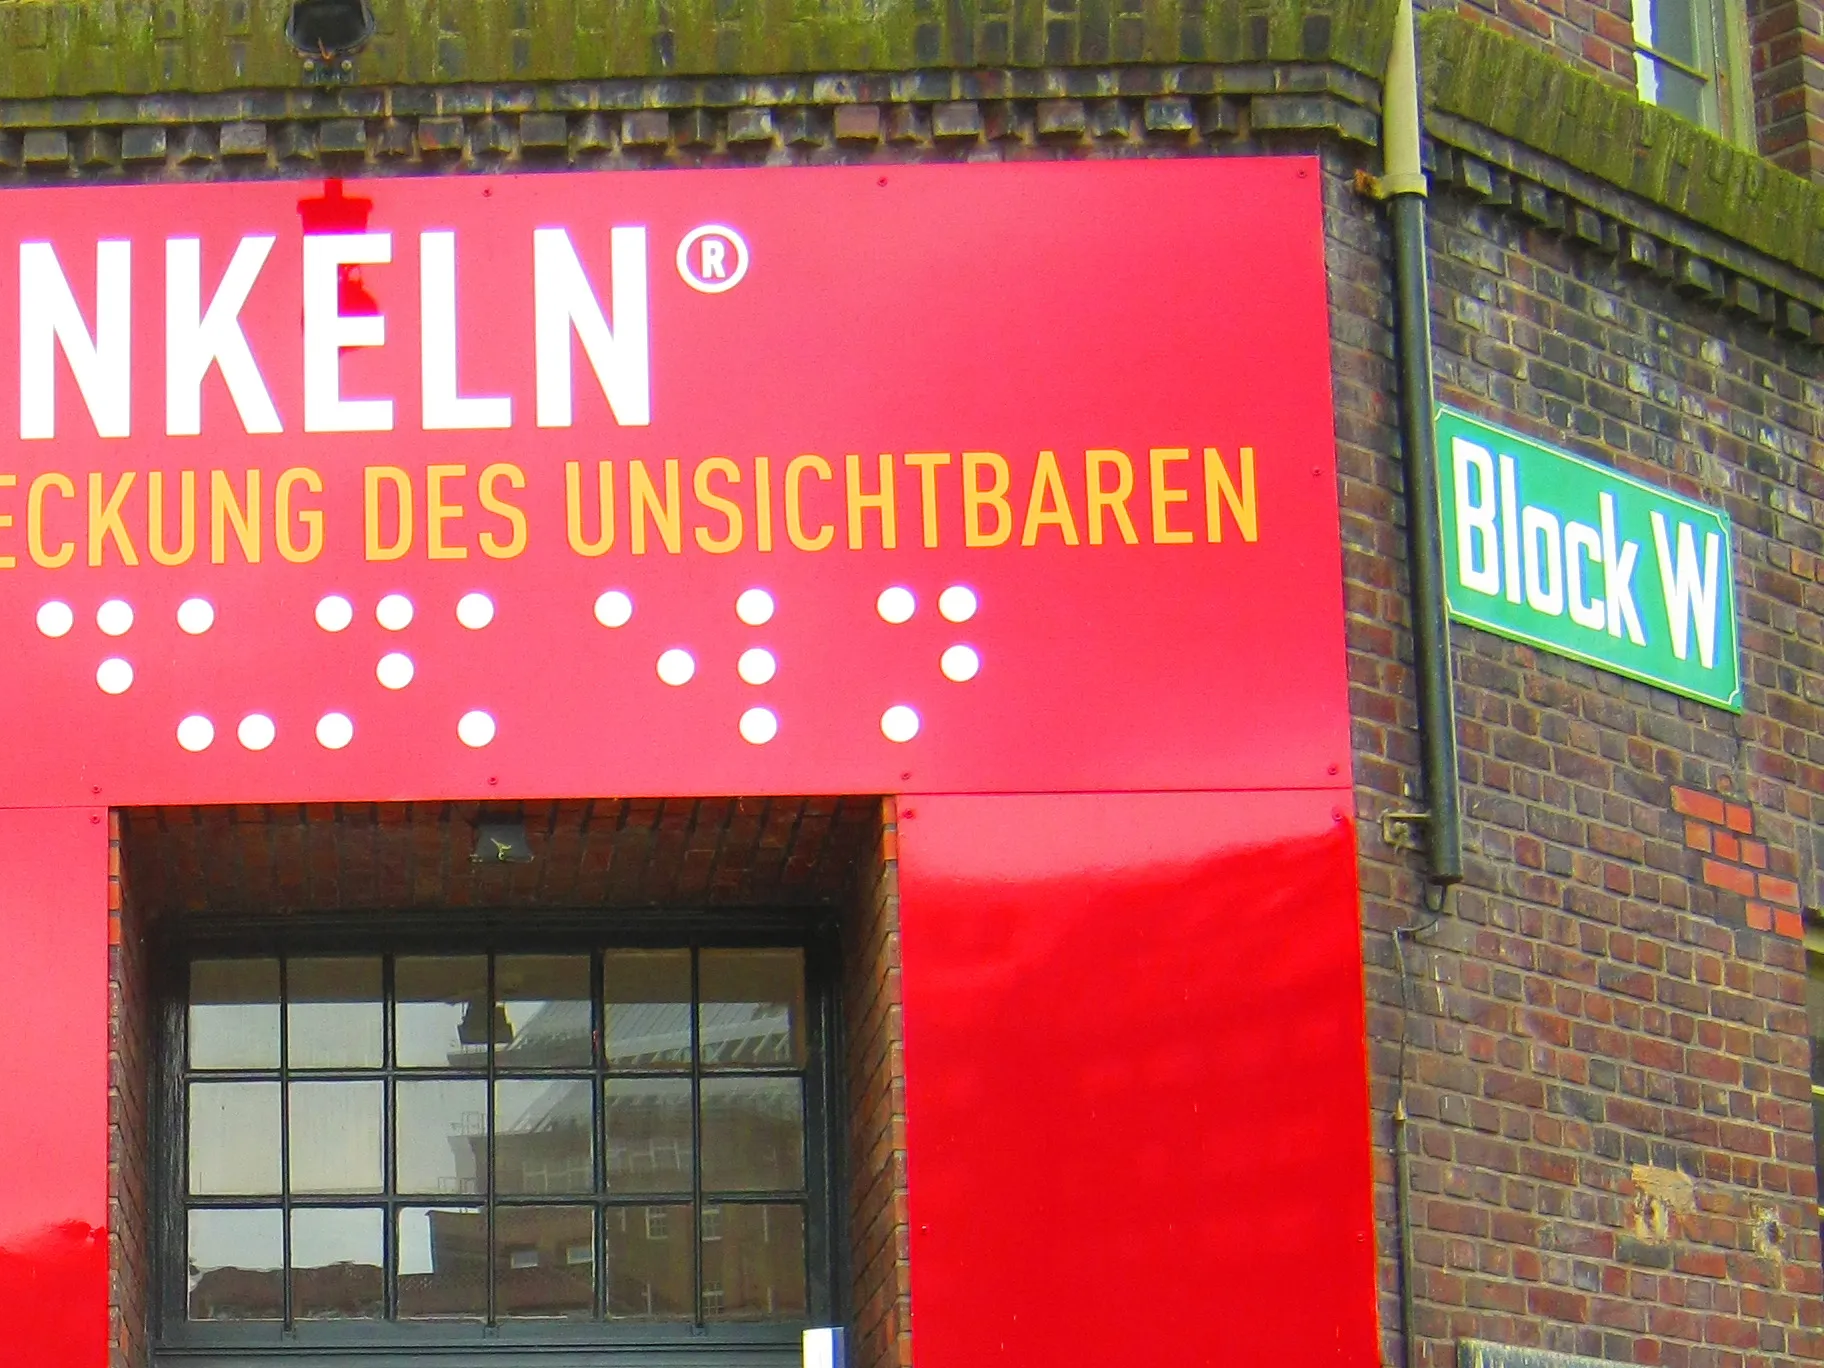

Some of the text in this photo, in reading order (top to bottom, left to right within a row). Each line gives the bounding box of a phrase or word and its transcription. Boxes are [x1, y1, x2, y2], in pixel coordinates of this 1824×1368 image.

[365, 463, 527, 560] DES
[566, 447, 1259, 556] UNSICHTBAREN
[1451, 436, 1719, 669] Block W
